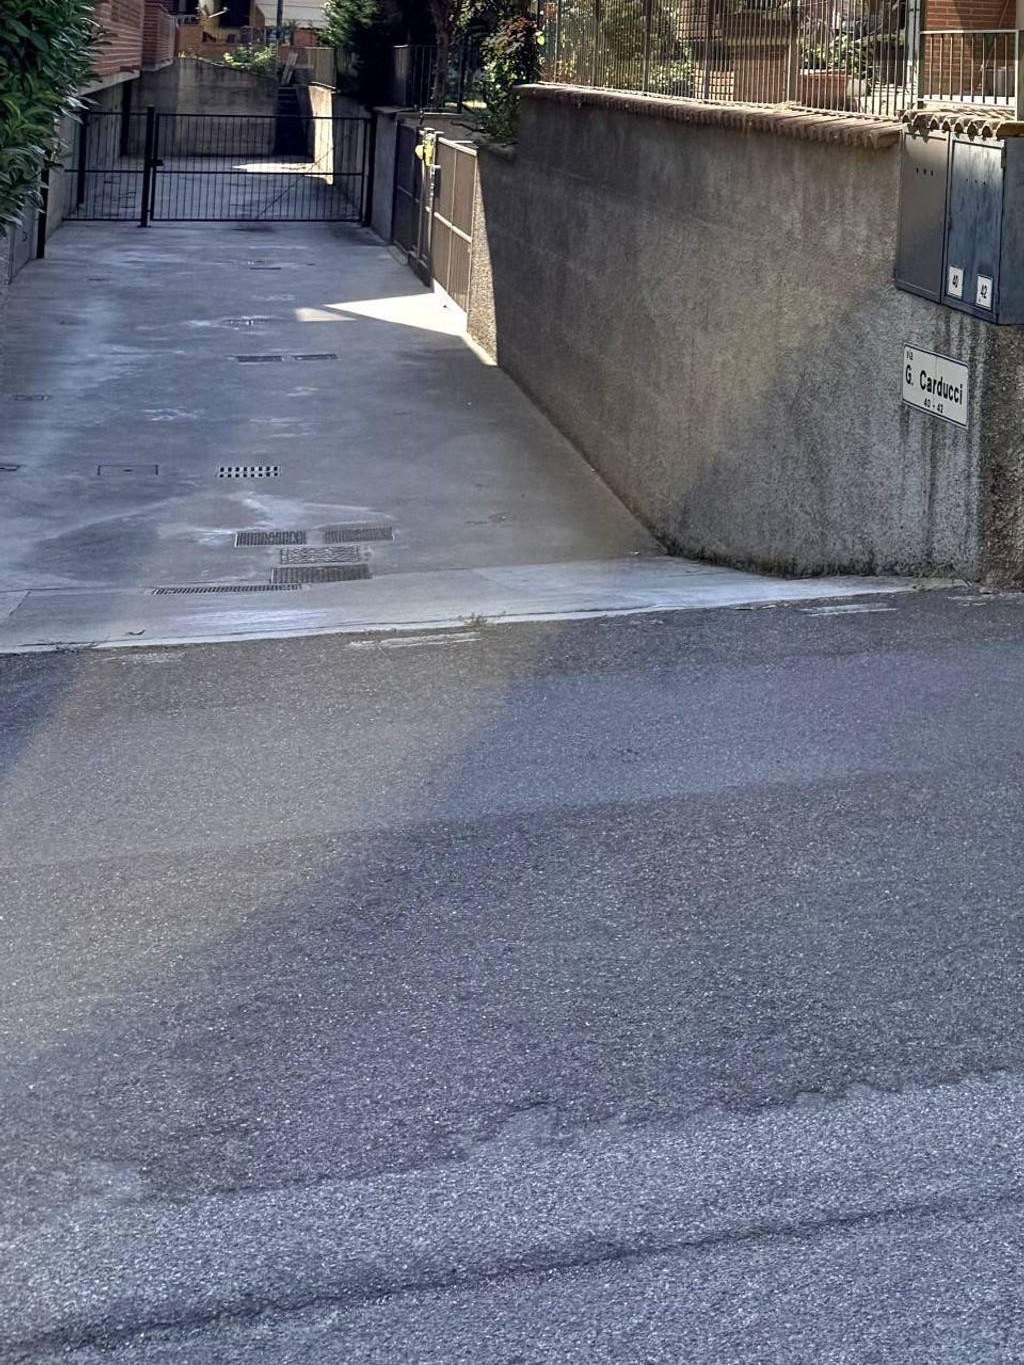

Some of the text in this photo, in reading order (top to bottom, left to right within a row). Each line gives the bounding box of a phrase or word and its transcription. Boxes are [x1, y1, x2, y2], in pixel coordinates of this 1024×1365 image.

[980, 284, 988, 299] 42
[905, 364, 963, 405] G. Carducci
